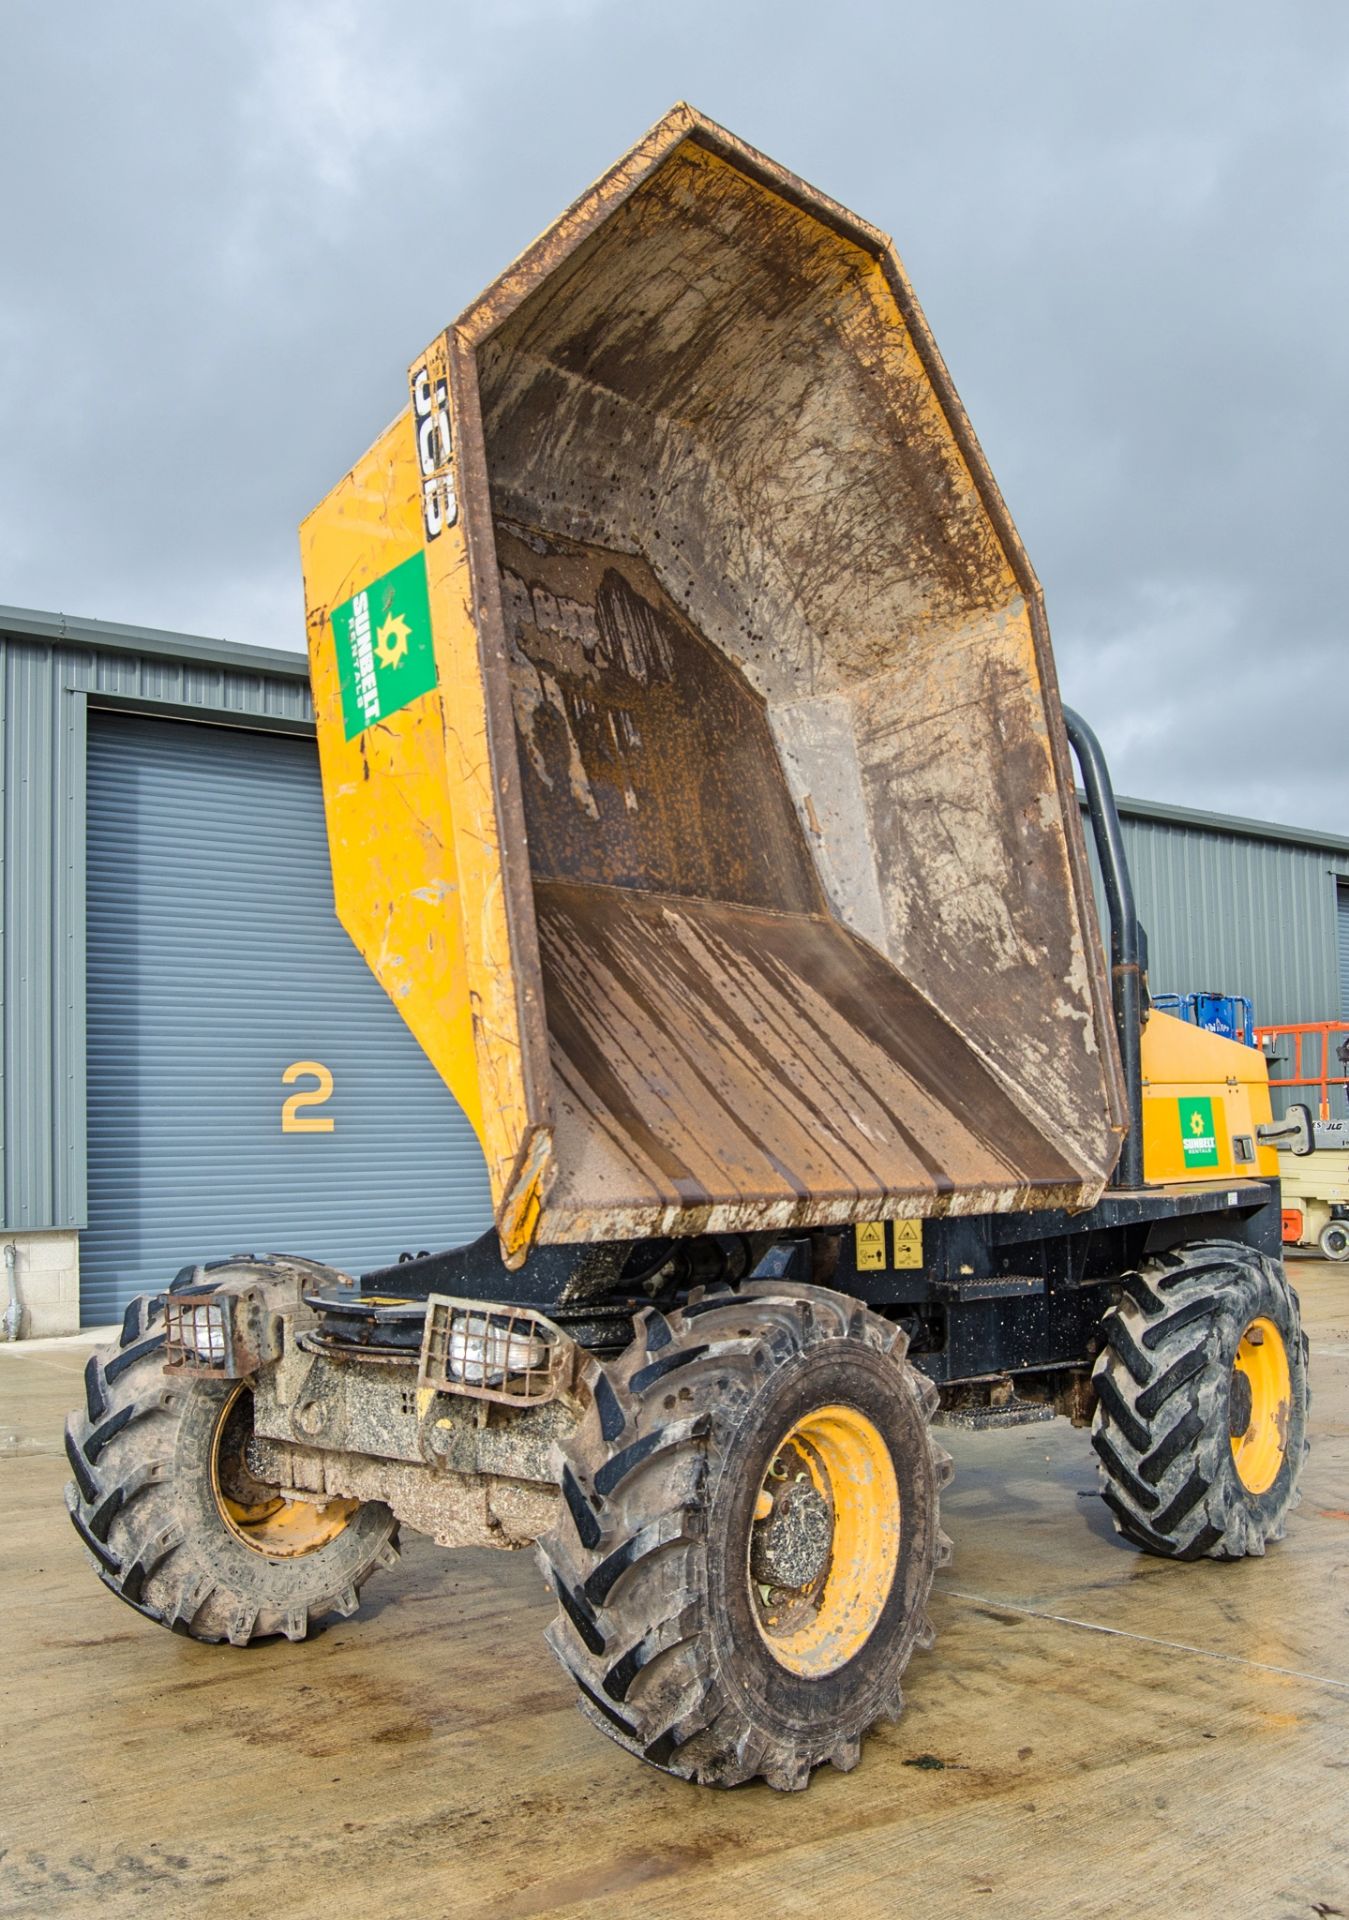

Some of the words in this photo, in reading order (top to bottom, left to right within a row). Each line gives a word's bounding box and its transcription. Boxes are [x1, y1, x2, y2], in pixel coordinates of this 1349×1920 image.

[414, 369, 459, 538] JCB
[347, 616, 363, 708] RENTALS
[352, 590, 380, 720] SUNBELT
[282, 1060, 335, 1133] 2
[1326, 1122, 1343, 1131] JLG
[1183, 1137, 1216, 1150] SUNBELT
